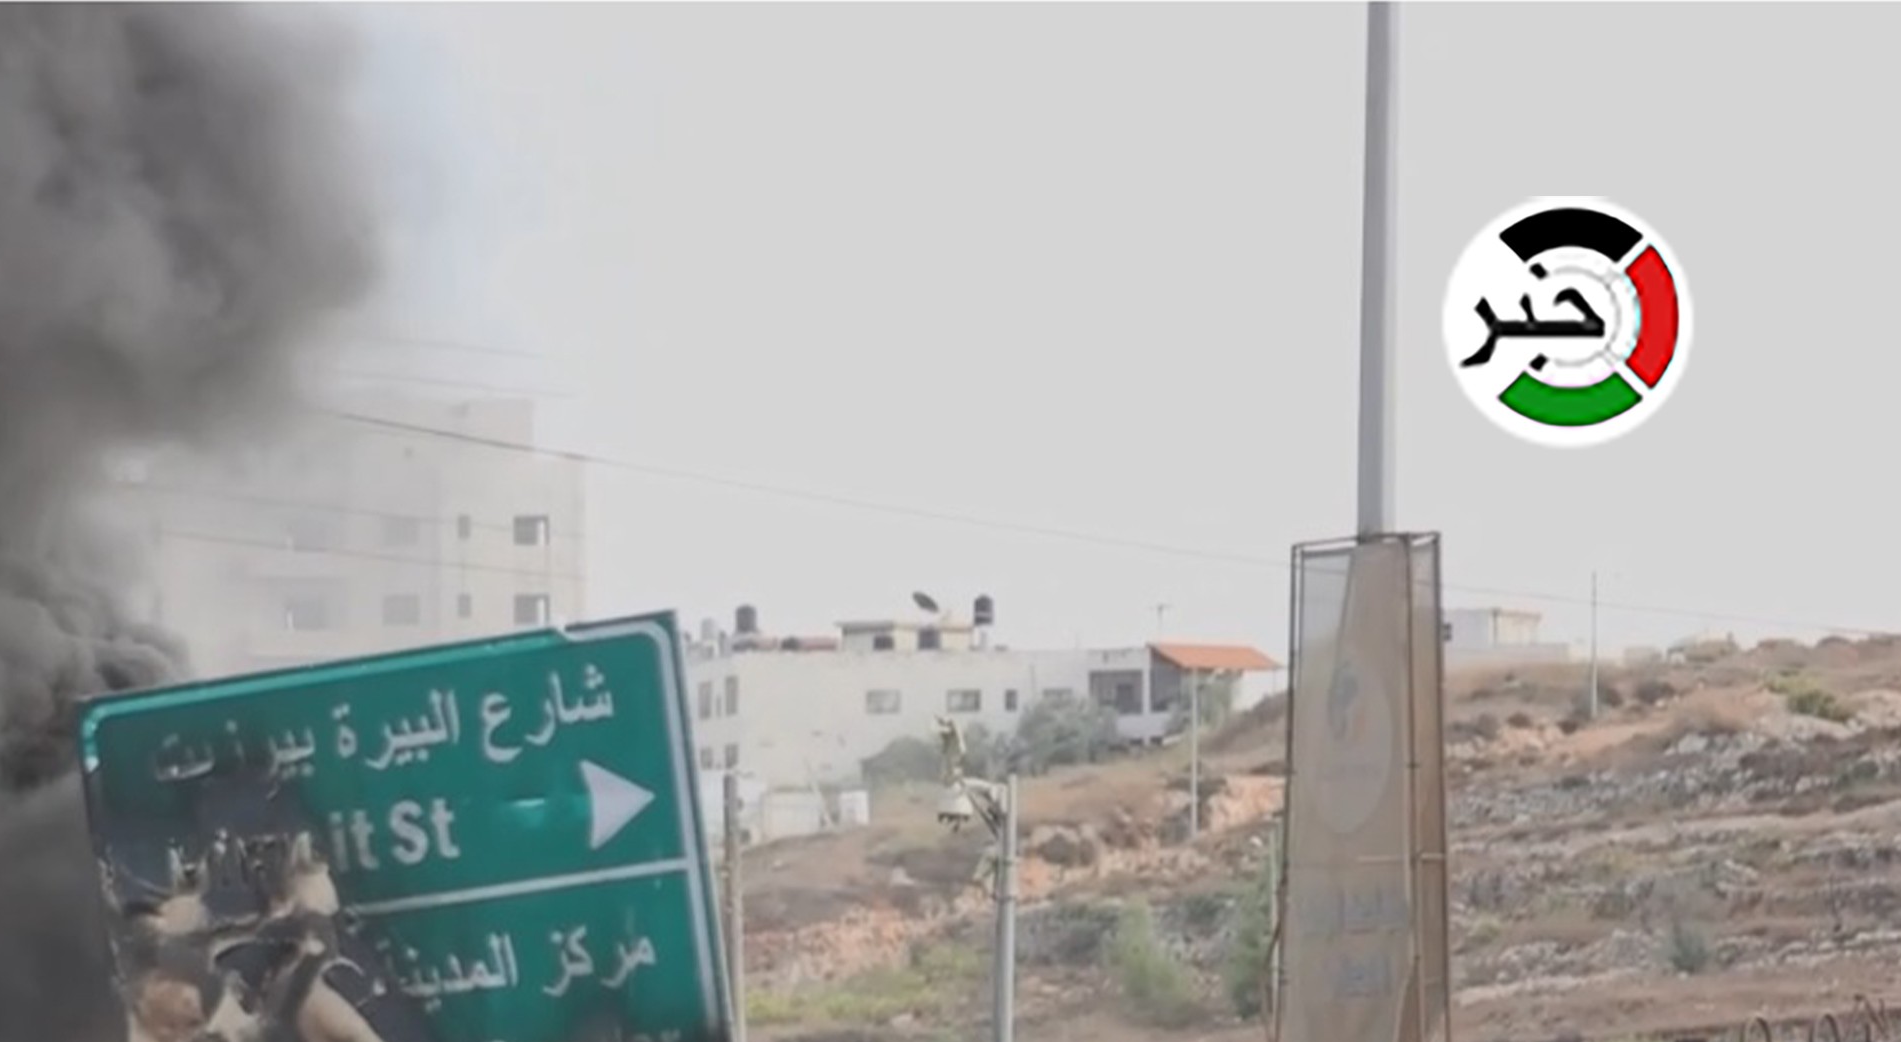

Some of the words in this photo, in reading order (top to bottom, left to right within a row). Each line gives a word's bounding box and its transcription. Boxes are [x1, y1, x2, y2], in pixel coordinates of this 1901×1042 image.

[331, 688, 461, 770] البيرة
[479, 663, 615, 763] شارع
[389, 798, 461, 866] St
[374, 932, 519, 1013] المدين
[542, 925, 656, 998] مركز
